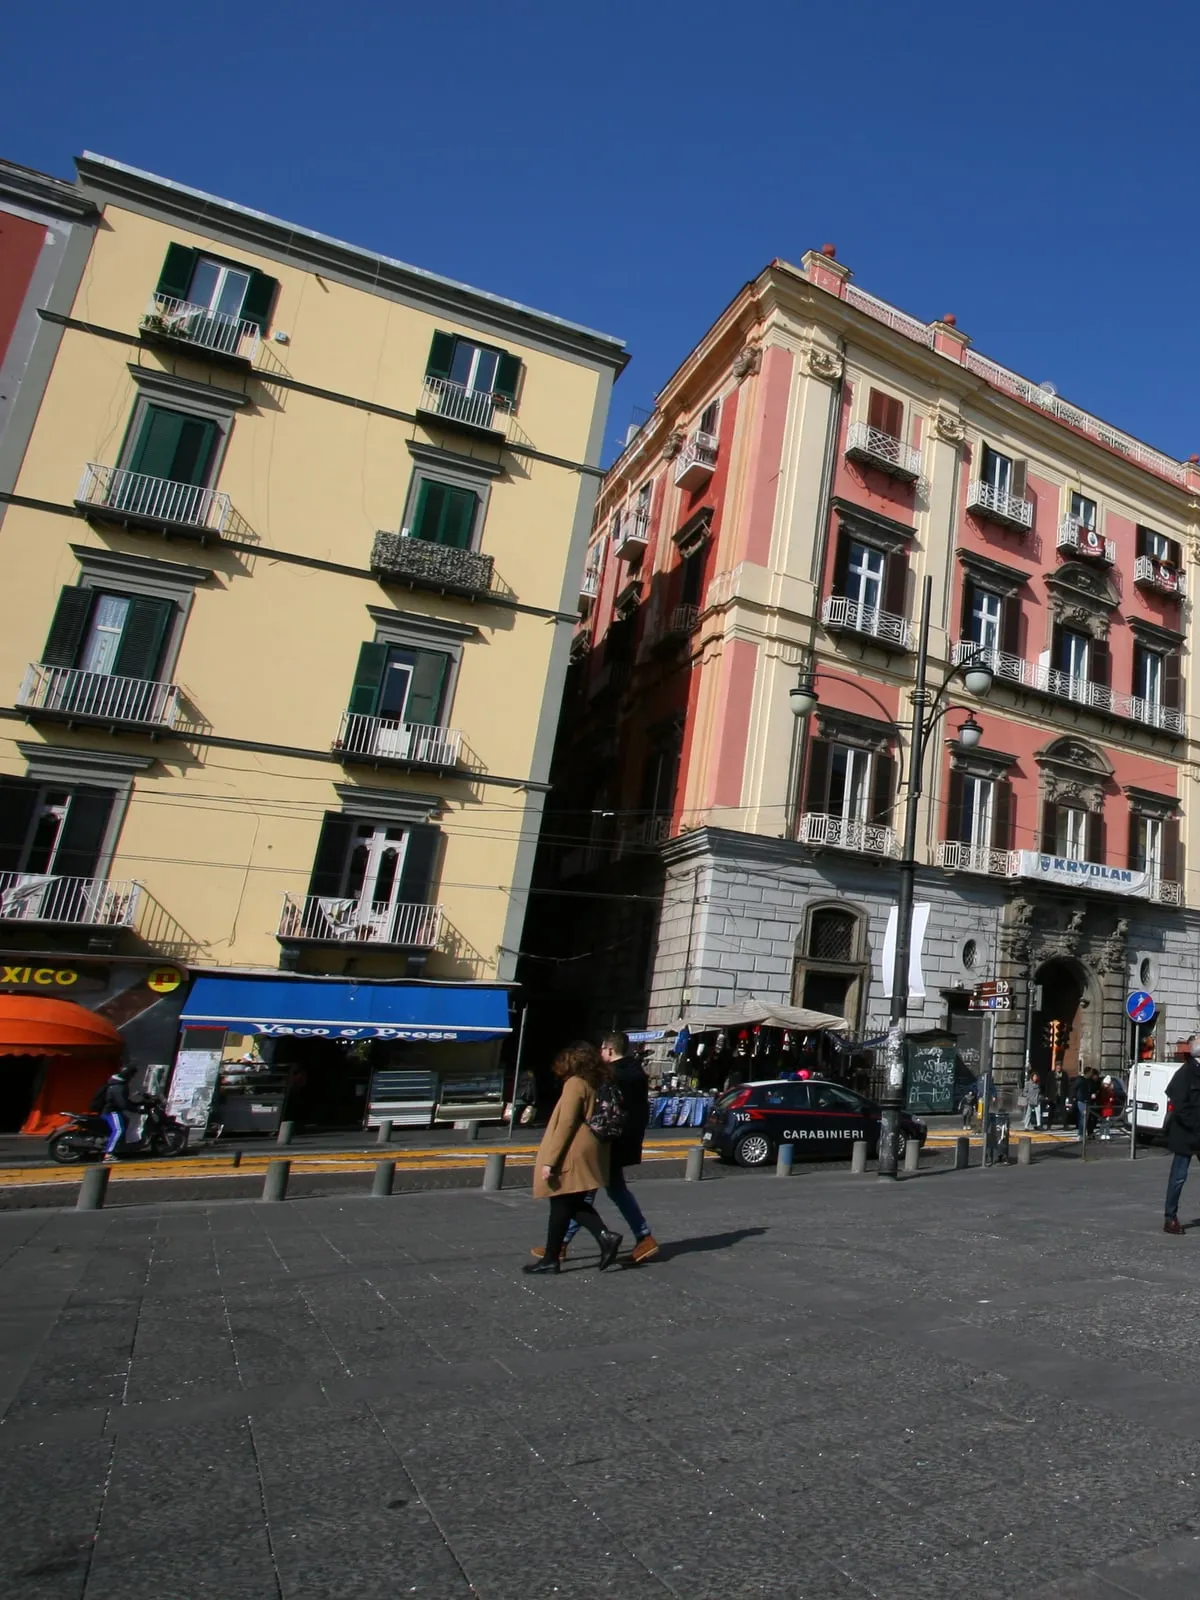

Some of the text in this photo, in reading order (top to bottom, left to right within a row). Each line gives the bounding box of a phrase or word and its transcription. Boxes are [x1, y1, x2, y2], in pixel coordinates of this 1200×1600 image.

[1054, 858, 1132, 882] KRYOLAN
[0, 966, 78, 985] XICO
[252, 1024, 330, 1036] Vaco
[375, 1027, 458, 1040] Press
[736, 1113, 751, 1122] 112
[783, 1130, 864, 1140] CARABINIERI
